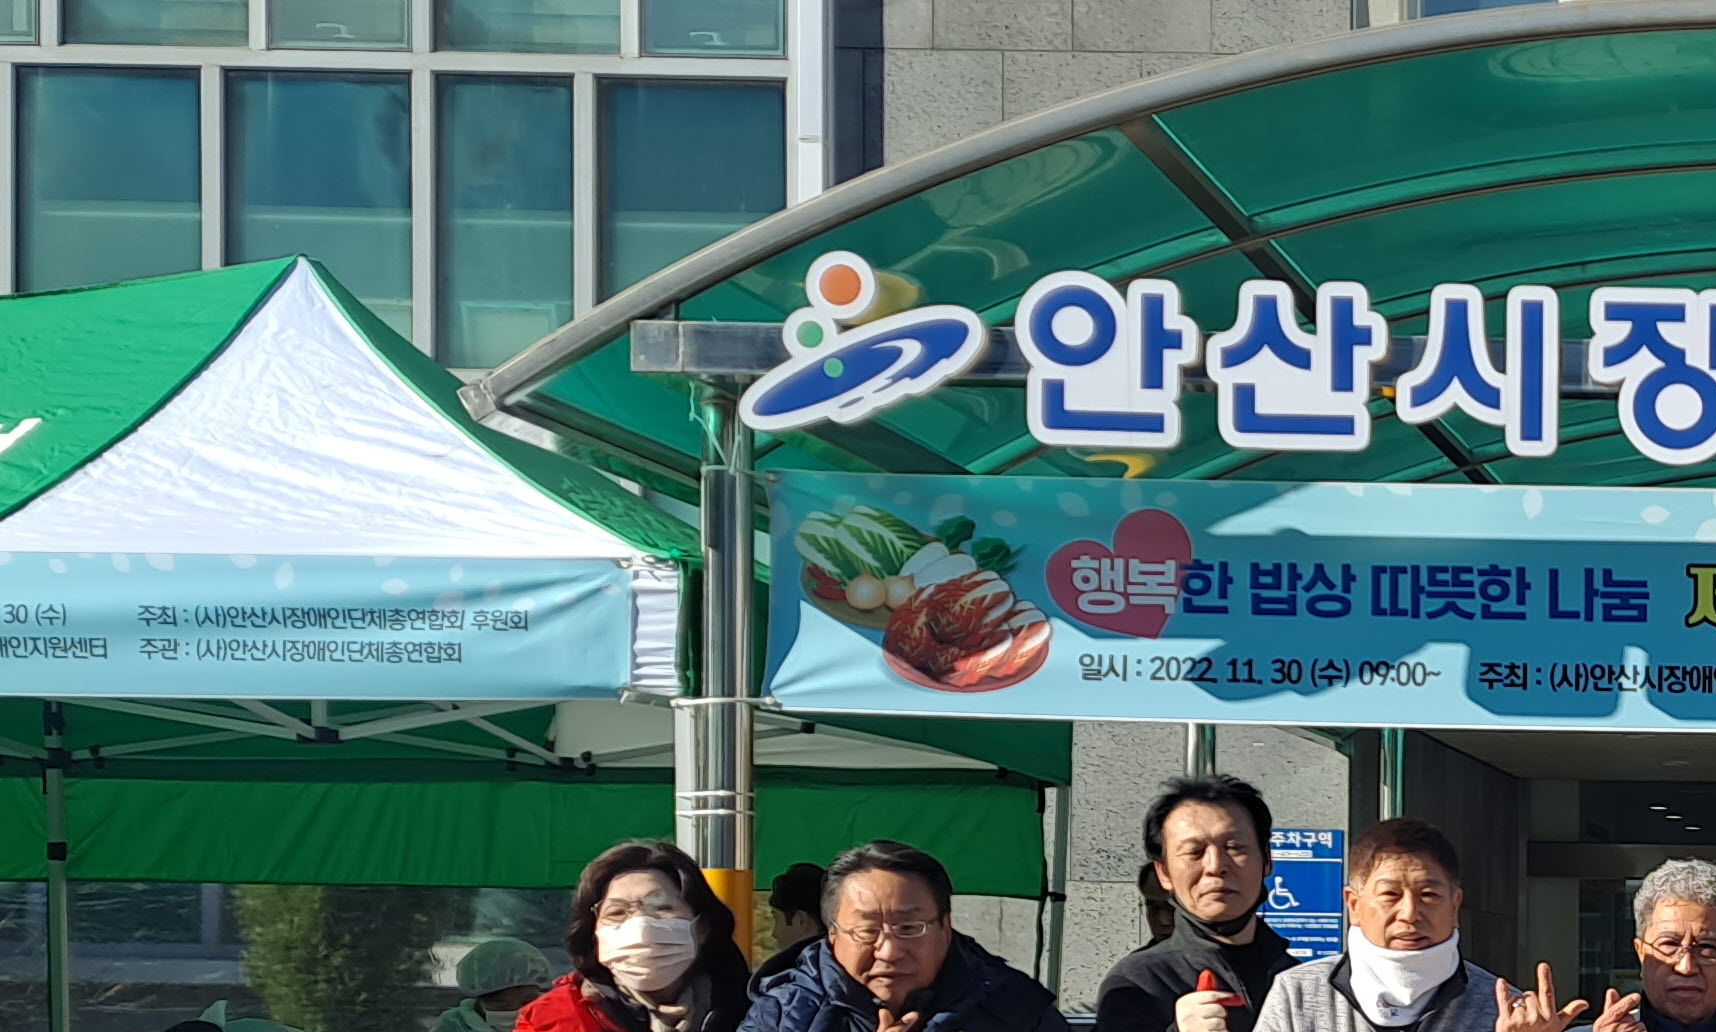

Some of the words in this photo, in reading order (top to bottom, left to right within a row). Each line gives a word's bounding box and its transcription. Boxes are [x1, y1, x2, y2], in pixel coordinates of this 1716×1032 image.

[1070, 554, 1233, 615] 행복한
[1249, 562, 1356, 619] 밥상
[1371, 563, 1531, 622] 따뜻한
[1548, 566, 1650, 623] 나눔
[3, 603, 29, 625] 30
[35, 602, 67, 627] (수)
[137, 605, 178, 627] 주최
[194, 605, 465, 631] (사)안산시장애인단체총연합회
[471, 609, 529, 632] 후원회
[138, 638, 179, 660] 주관
[196, 638, 462, 664] (사)안산시장애인단체총연합회
[1078, 652, 1129, 682] 일시
[1270, 658, 1303, 685] 30
[1311, 657, 1351, 688] (수)
[1358, 660, 1442, 688] 09:00~
[1478, 661, 1529, 691] 주최
